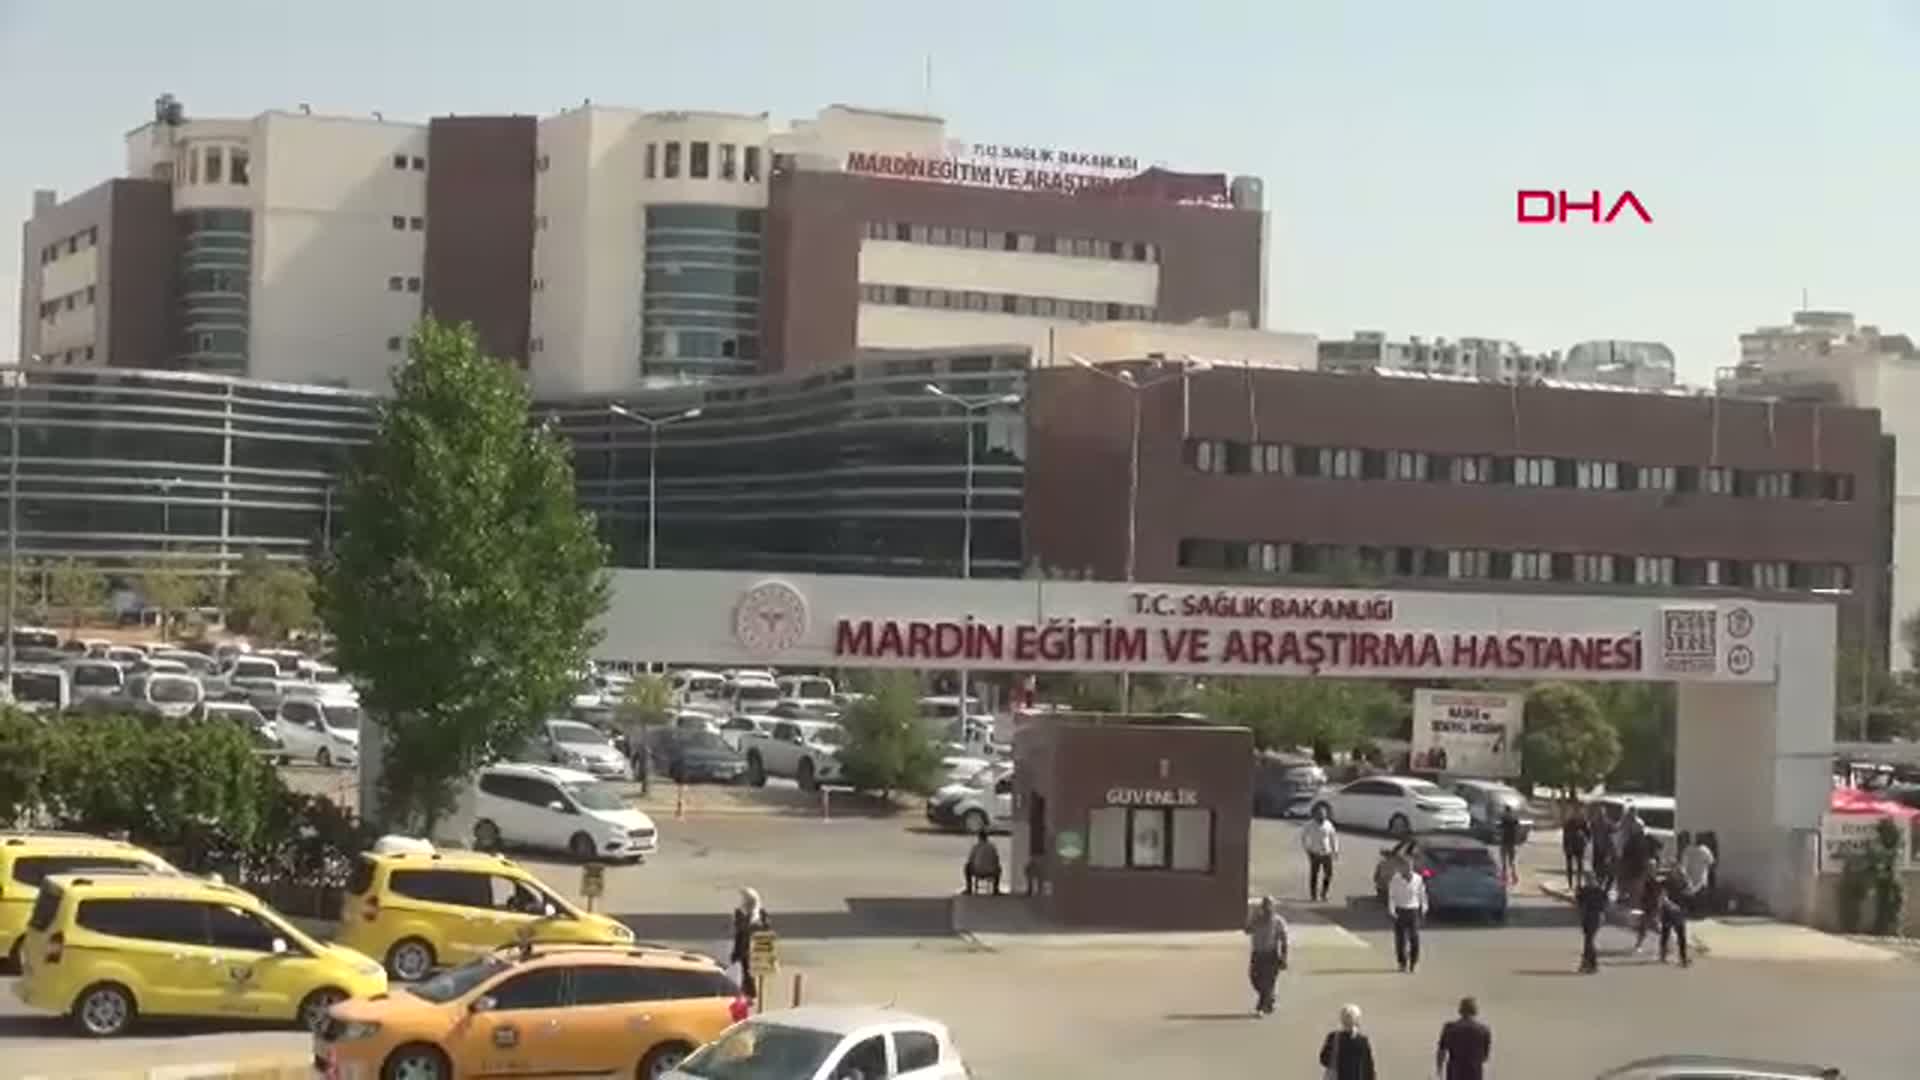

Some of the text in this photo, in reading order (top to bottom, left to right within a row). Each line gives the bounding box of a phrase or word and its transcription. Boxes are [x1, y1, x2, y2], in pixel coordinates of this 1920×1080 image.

[848, 152, 926, 176] MARDİN
[928, 156, 991, 183] EĞİTİM
[995, 168, 1020, 186] VE
[1131, 590, 1394, 621] T.C. SAĞLIK BAKANLIĞI
[834, 615, 1003, 659] MARDİN
[1014, 618, 1148, 664] EĞİTİM
[1160, 628, 1210, 663] VE
[1222, 630, 1442, 674] ARAŞTIRMA
[1452, 630, 1643, 672] HASTANESİ
